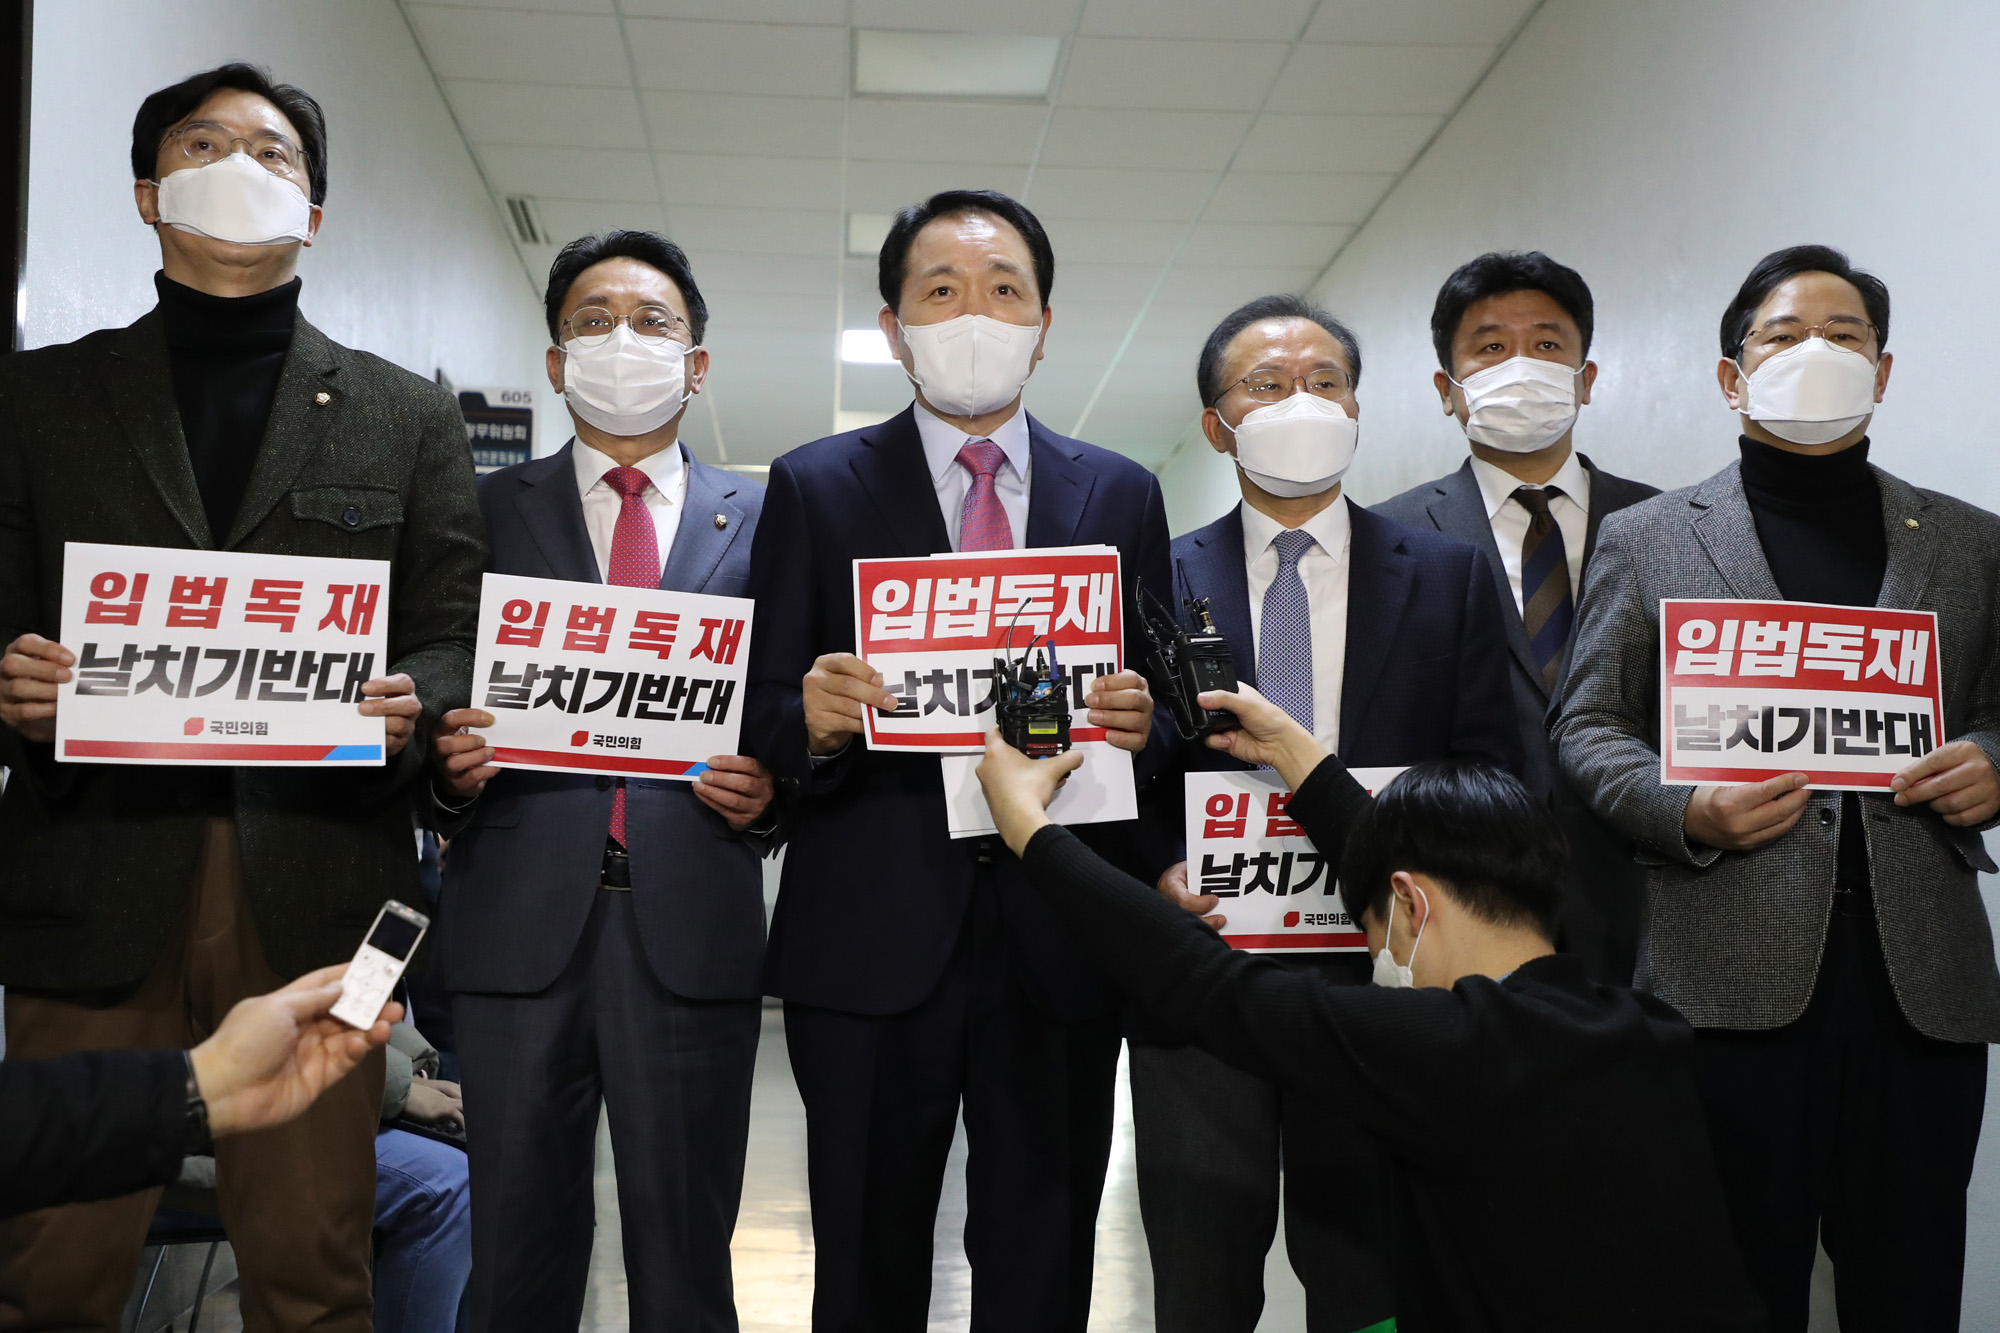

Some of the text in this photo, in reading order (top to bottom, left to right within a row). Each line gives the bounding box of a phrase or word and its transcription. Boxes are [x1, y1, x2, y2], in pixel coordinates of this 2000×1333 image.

[501, 391, 532, 404] 605
[869, 573, 1114, 641] 입법독재
[74, 643, 375, 703] 날치기반대
[1674, 619, 1930, 686] 입법독재
[484, 660, 736, 725] 날치기반대
[209, 720, 269, 736] 국민의힘
[592, 734, 642, 750] 국민의힘
[1674, 704, 1934, 758] 날치기반대
